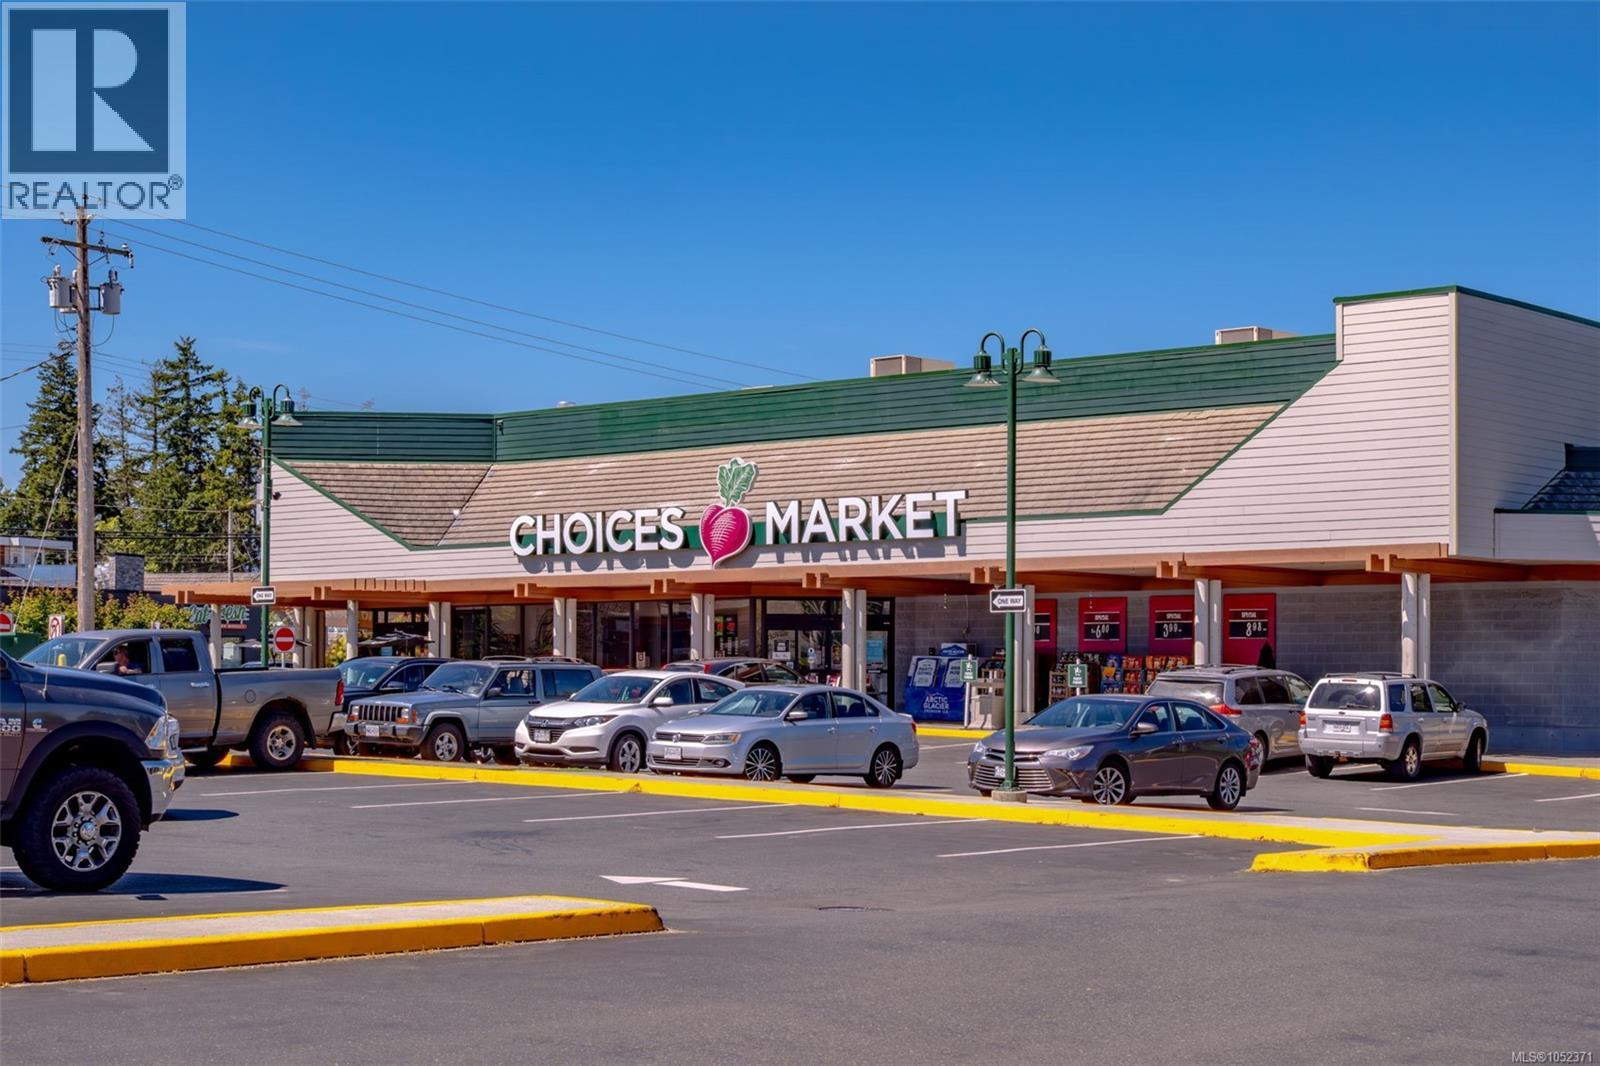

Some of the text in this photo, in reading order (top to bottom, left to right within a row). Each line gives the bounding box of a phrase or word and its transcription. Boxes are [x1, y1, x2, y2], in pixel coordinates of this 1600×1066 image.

[509, 489, 967, 557] CHOICES MARKET
[926, 695, 948, 703] ARCTIC
[923, 702, 950, 710] GLACIER
